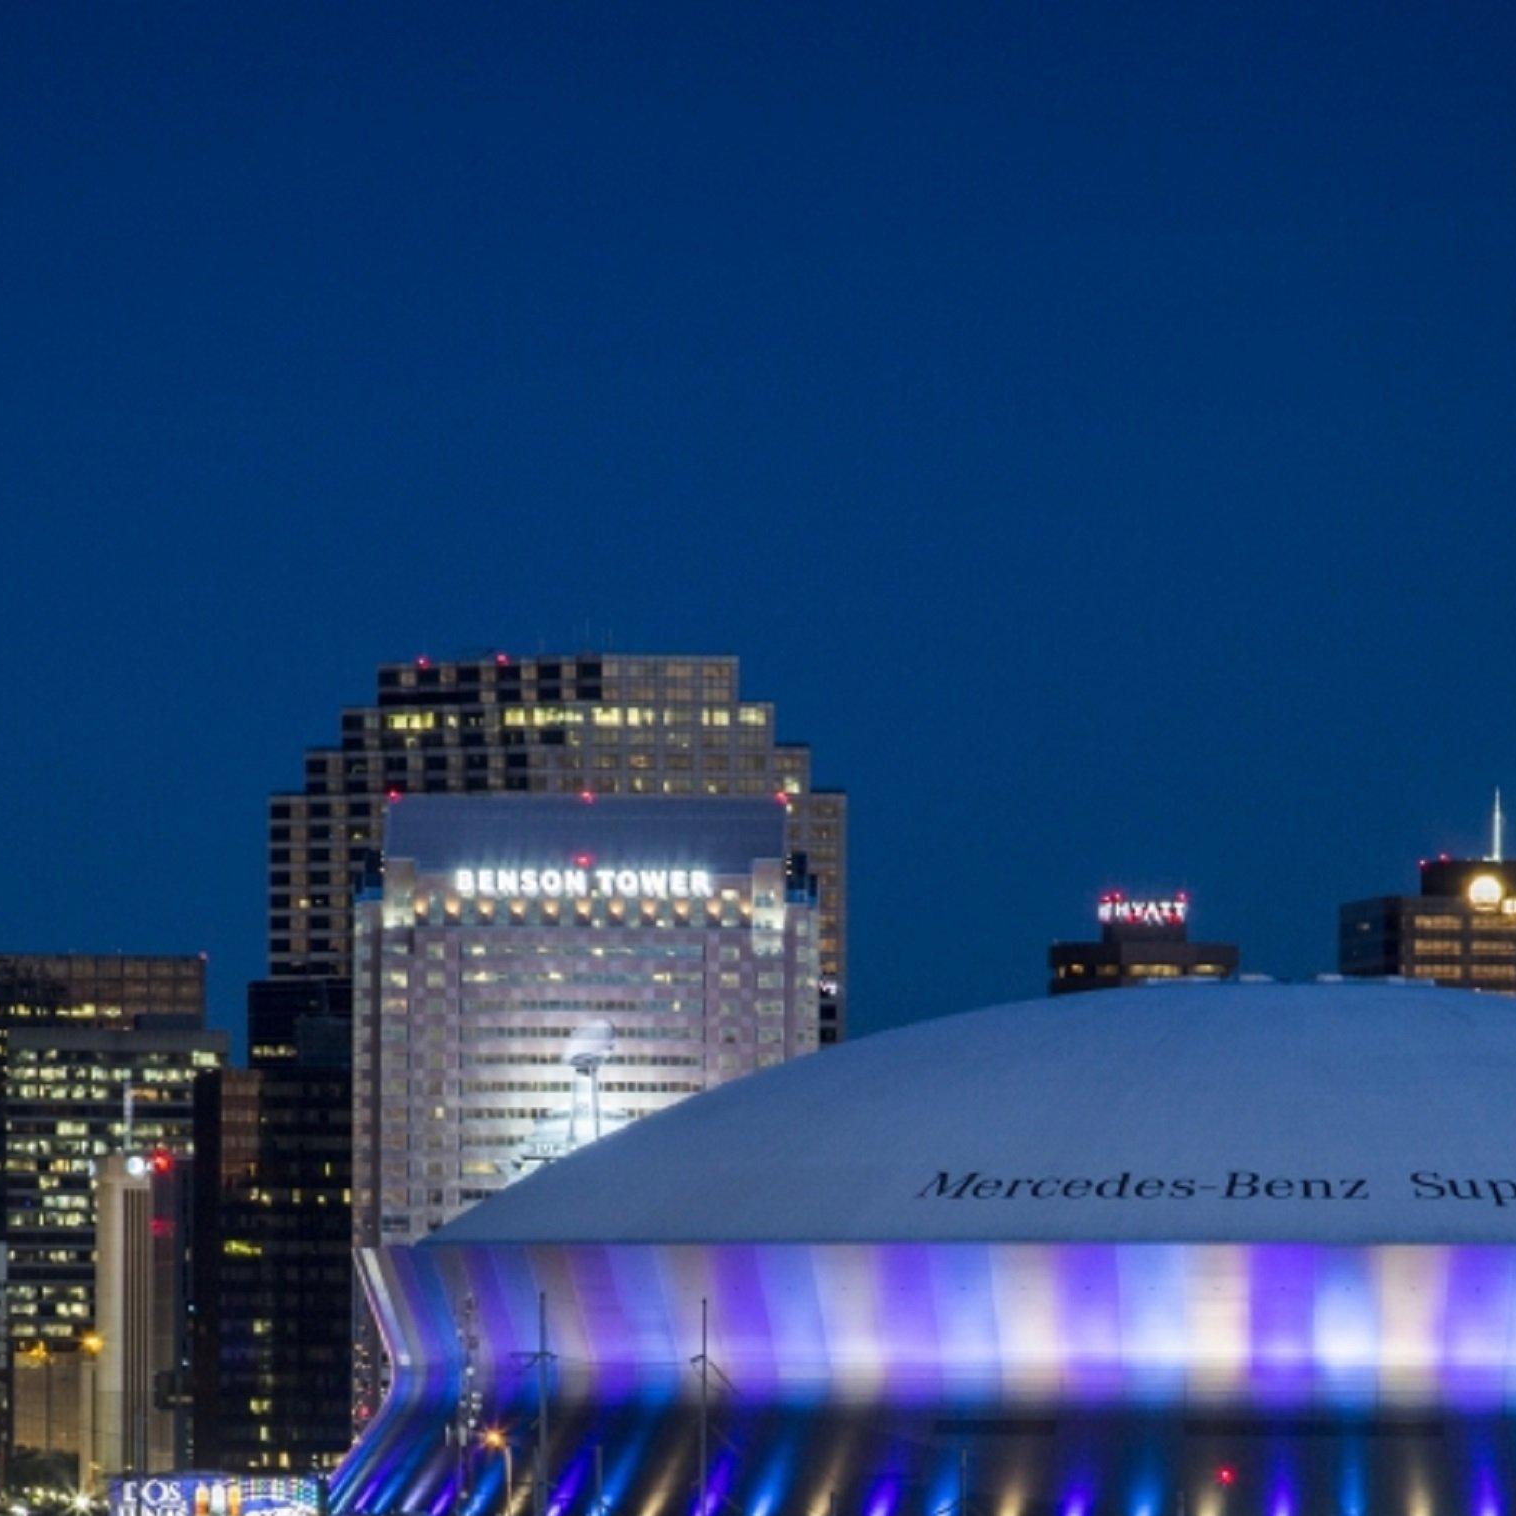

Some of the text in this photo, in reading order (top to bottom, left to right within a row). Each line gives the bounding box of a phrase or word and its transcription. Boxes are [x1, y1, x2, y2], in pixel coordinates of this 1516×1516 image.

[455, 869, 713, 898] BENSON TOWER
[1115, 901, 1187, 926] HYATT
[916, 1169, 1371, 1202] Mercedes-Benz
